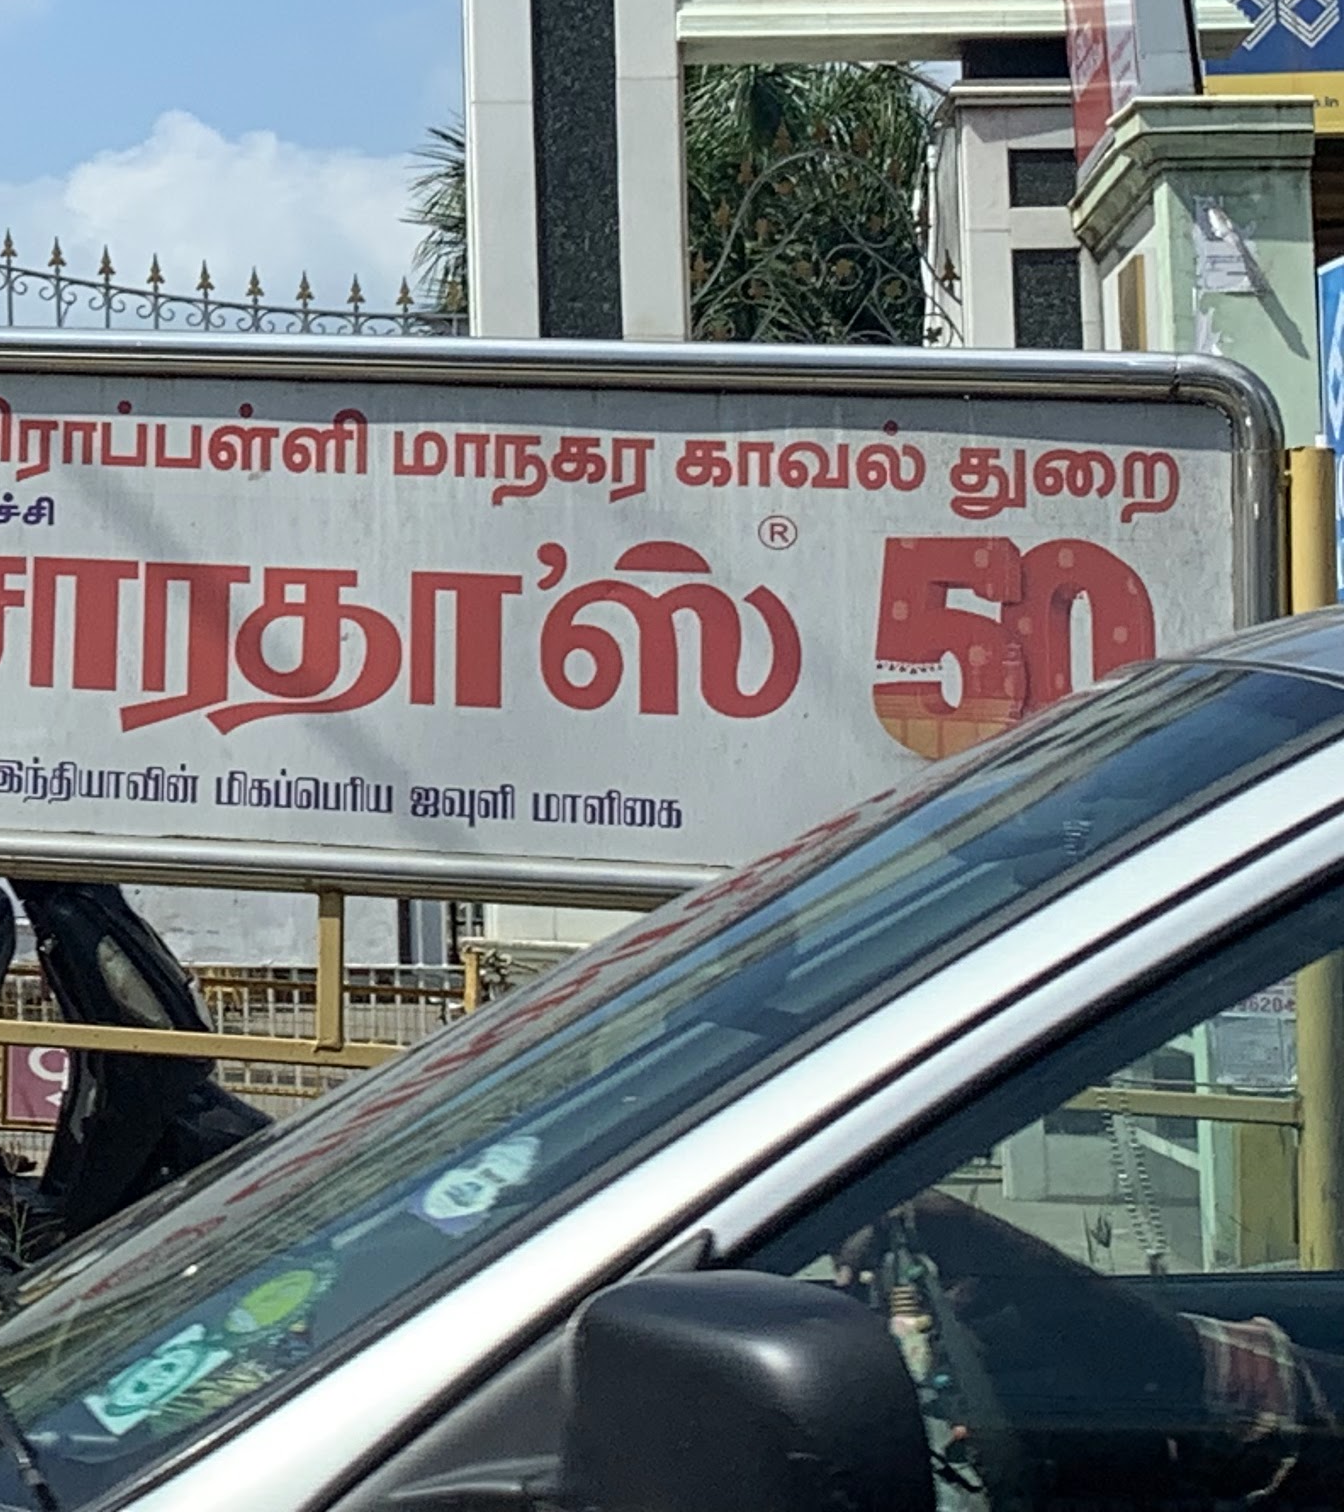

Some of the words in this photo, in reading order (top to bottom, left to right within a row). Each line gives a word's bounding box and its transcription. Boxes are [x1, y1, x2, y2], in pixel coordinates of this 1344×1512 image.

[392, 430, 656, 505] மாநகர
[675, 419, 927, 493] காவல்
[950, 447, 1180, 523] துறை
[872, 536, 1157, 762] 50
[214, 768, 394, 815] மிகப்பெரிய
[409, 783, 515, 828] ஜவுளி
[532, 789, 682, 830] மாளிகை
